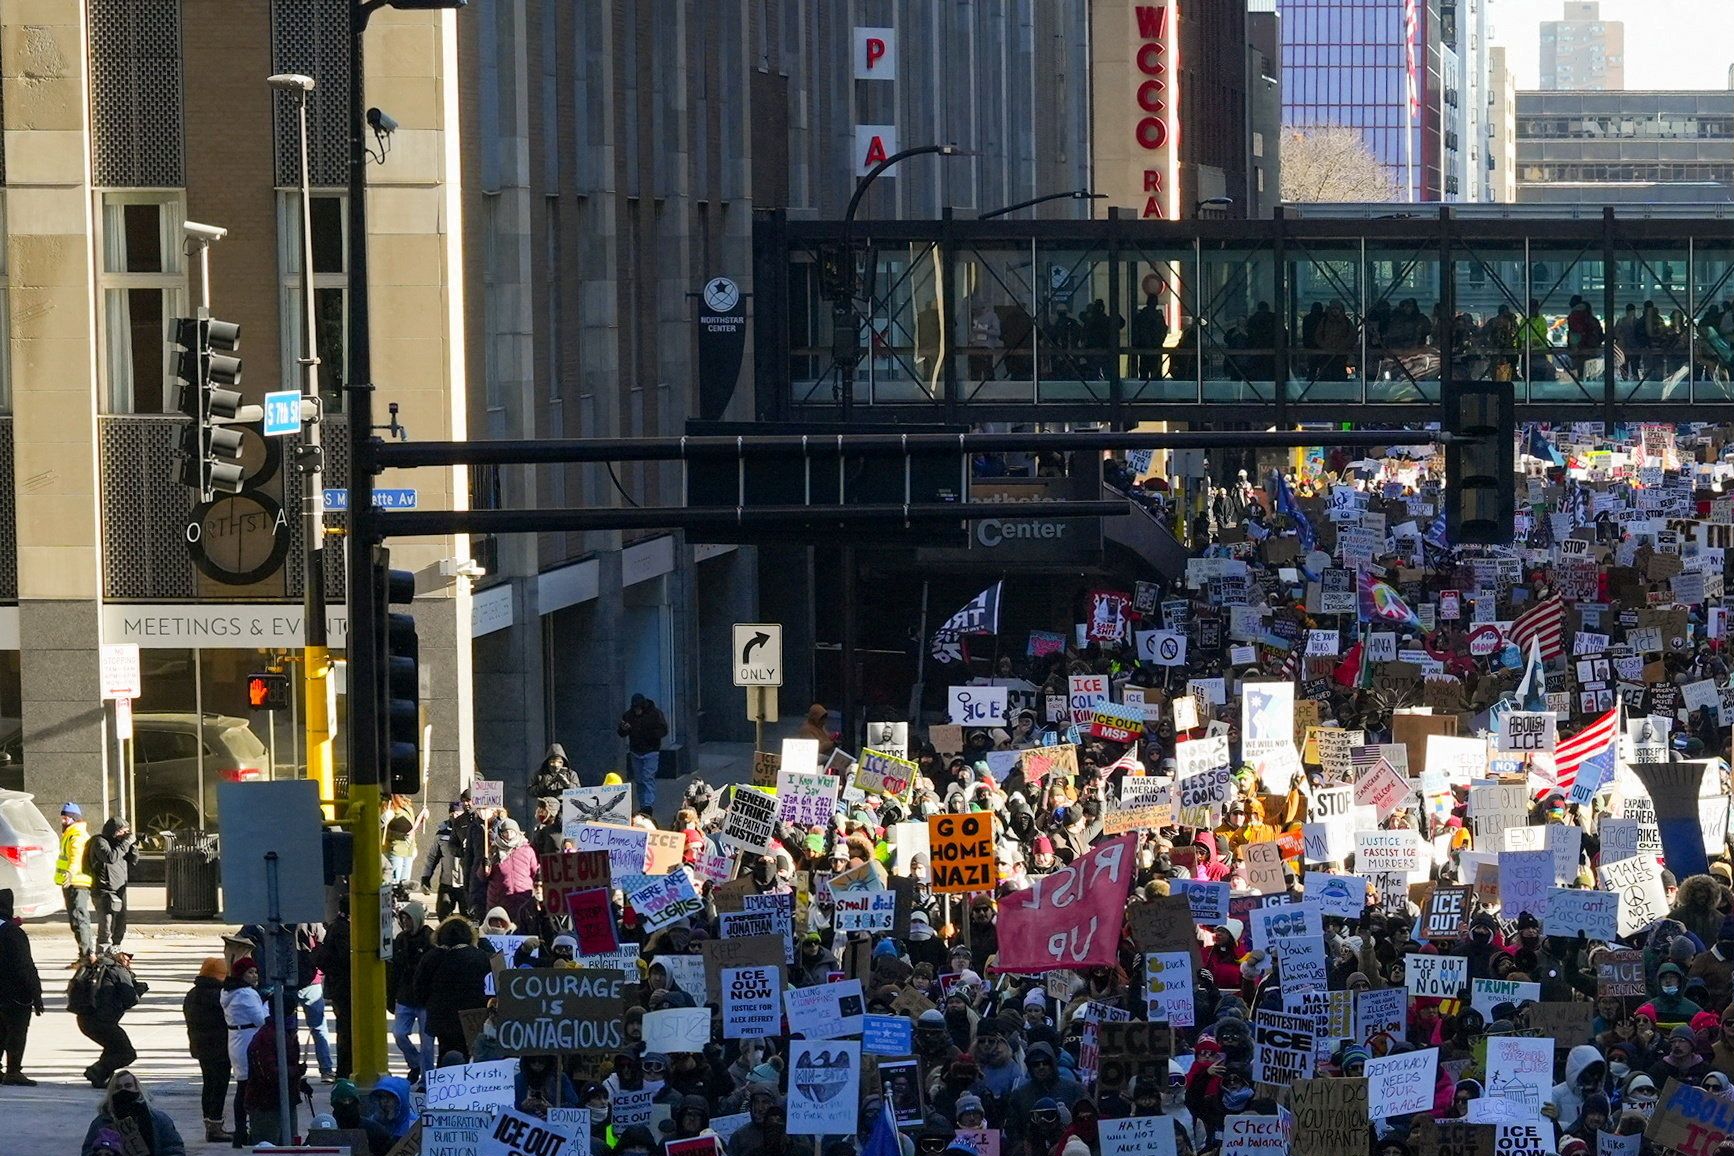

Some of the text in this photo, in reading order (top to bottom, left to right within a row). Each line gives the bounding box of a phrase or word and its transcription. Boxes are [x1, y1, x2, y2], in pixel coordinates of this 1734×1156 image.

[1135, 6, 1167, 150] WCCO
[701, 316, 744, 324] NORTHSTAR
[338, 492, 393, 506] Mette
[978, 518, 1066, 547] Center
[1563, 539, 1586, 553] STOP
[124, 618, 347, 637] MEETINGS & EVNT
[740, 668, 775, 680] ONLY
[1092, 714, 1140, 732] ICE OUT
[1510, 716, 1545, 734] ABOLISH
[1100, 727, 1130, 740] MSP
[1510, 731, 1544, 750] ICE
[735, 789, 776, 808] GENERAL
[731, 801, 775, 823] STRIKE:
[730, 814, 771, 834] THE PATH TO
[937, 820, 978, 837] GO
[726, 823, 765, 848] JUSTICE
[1359, 837, 1399, 847] JUSTICE
[931, 839, 991, 863] HOME
[1364, 848, 1416, 858] FASCIST ICE
[1368, 859, 1415, 870] MURDERS
[933, 863, 990, 885] NAZI
[1413, 960, 1463, 971] ICE OUT
[734, 970, 768, 980] ICE
[1421, 970, 1462, 980] OF MN
[512, 977, 620, 999] COURAGE
[733, 979, 769, 991] OUT
[732, 989, 771, 999] NOW
[542, 999, 563, 1015] IS
[500, 1018, 621, 1050] CONTAGIOUS
[496, 1113, 524, 1143] ICE
[1503, 1126, 1536, 1138] ICE
[1498, 1137, 1542, 1150] OUT
